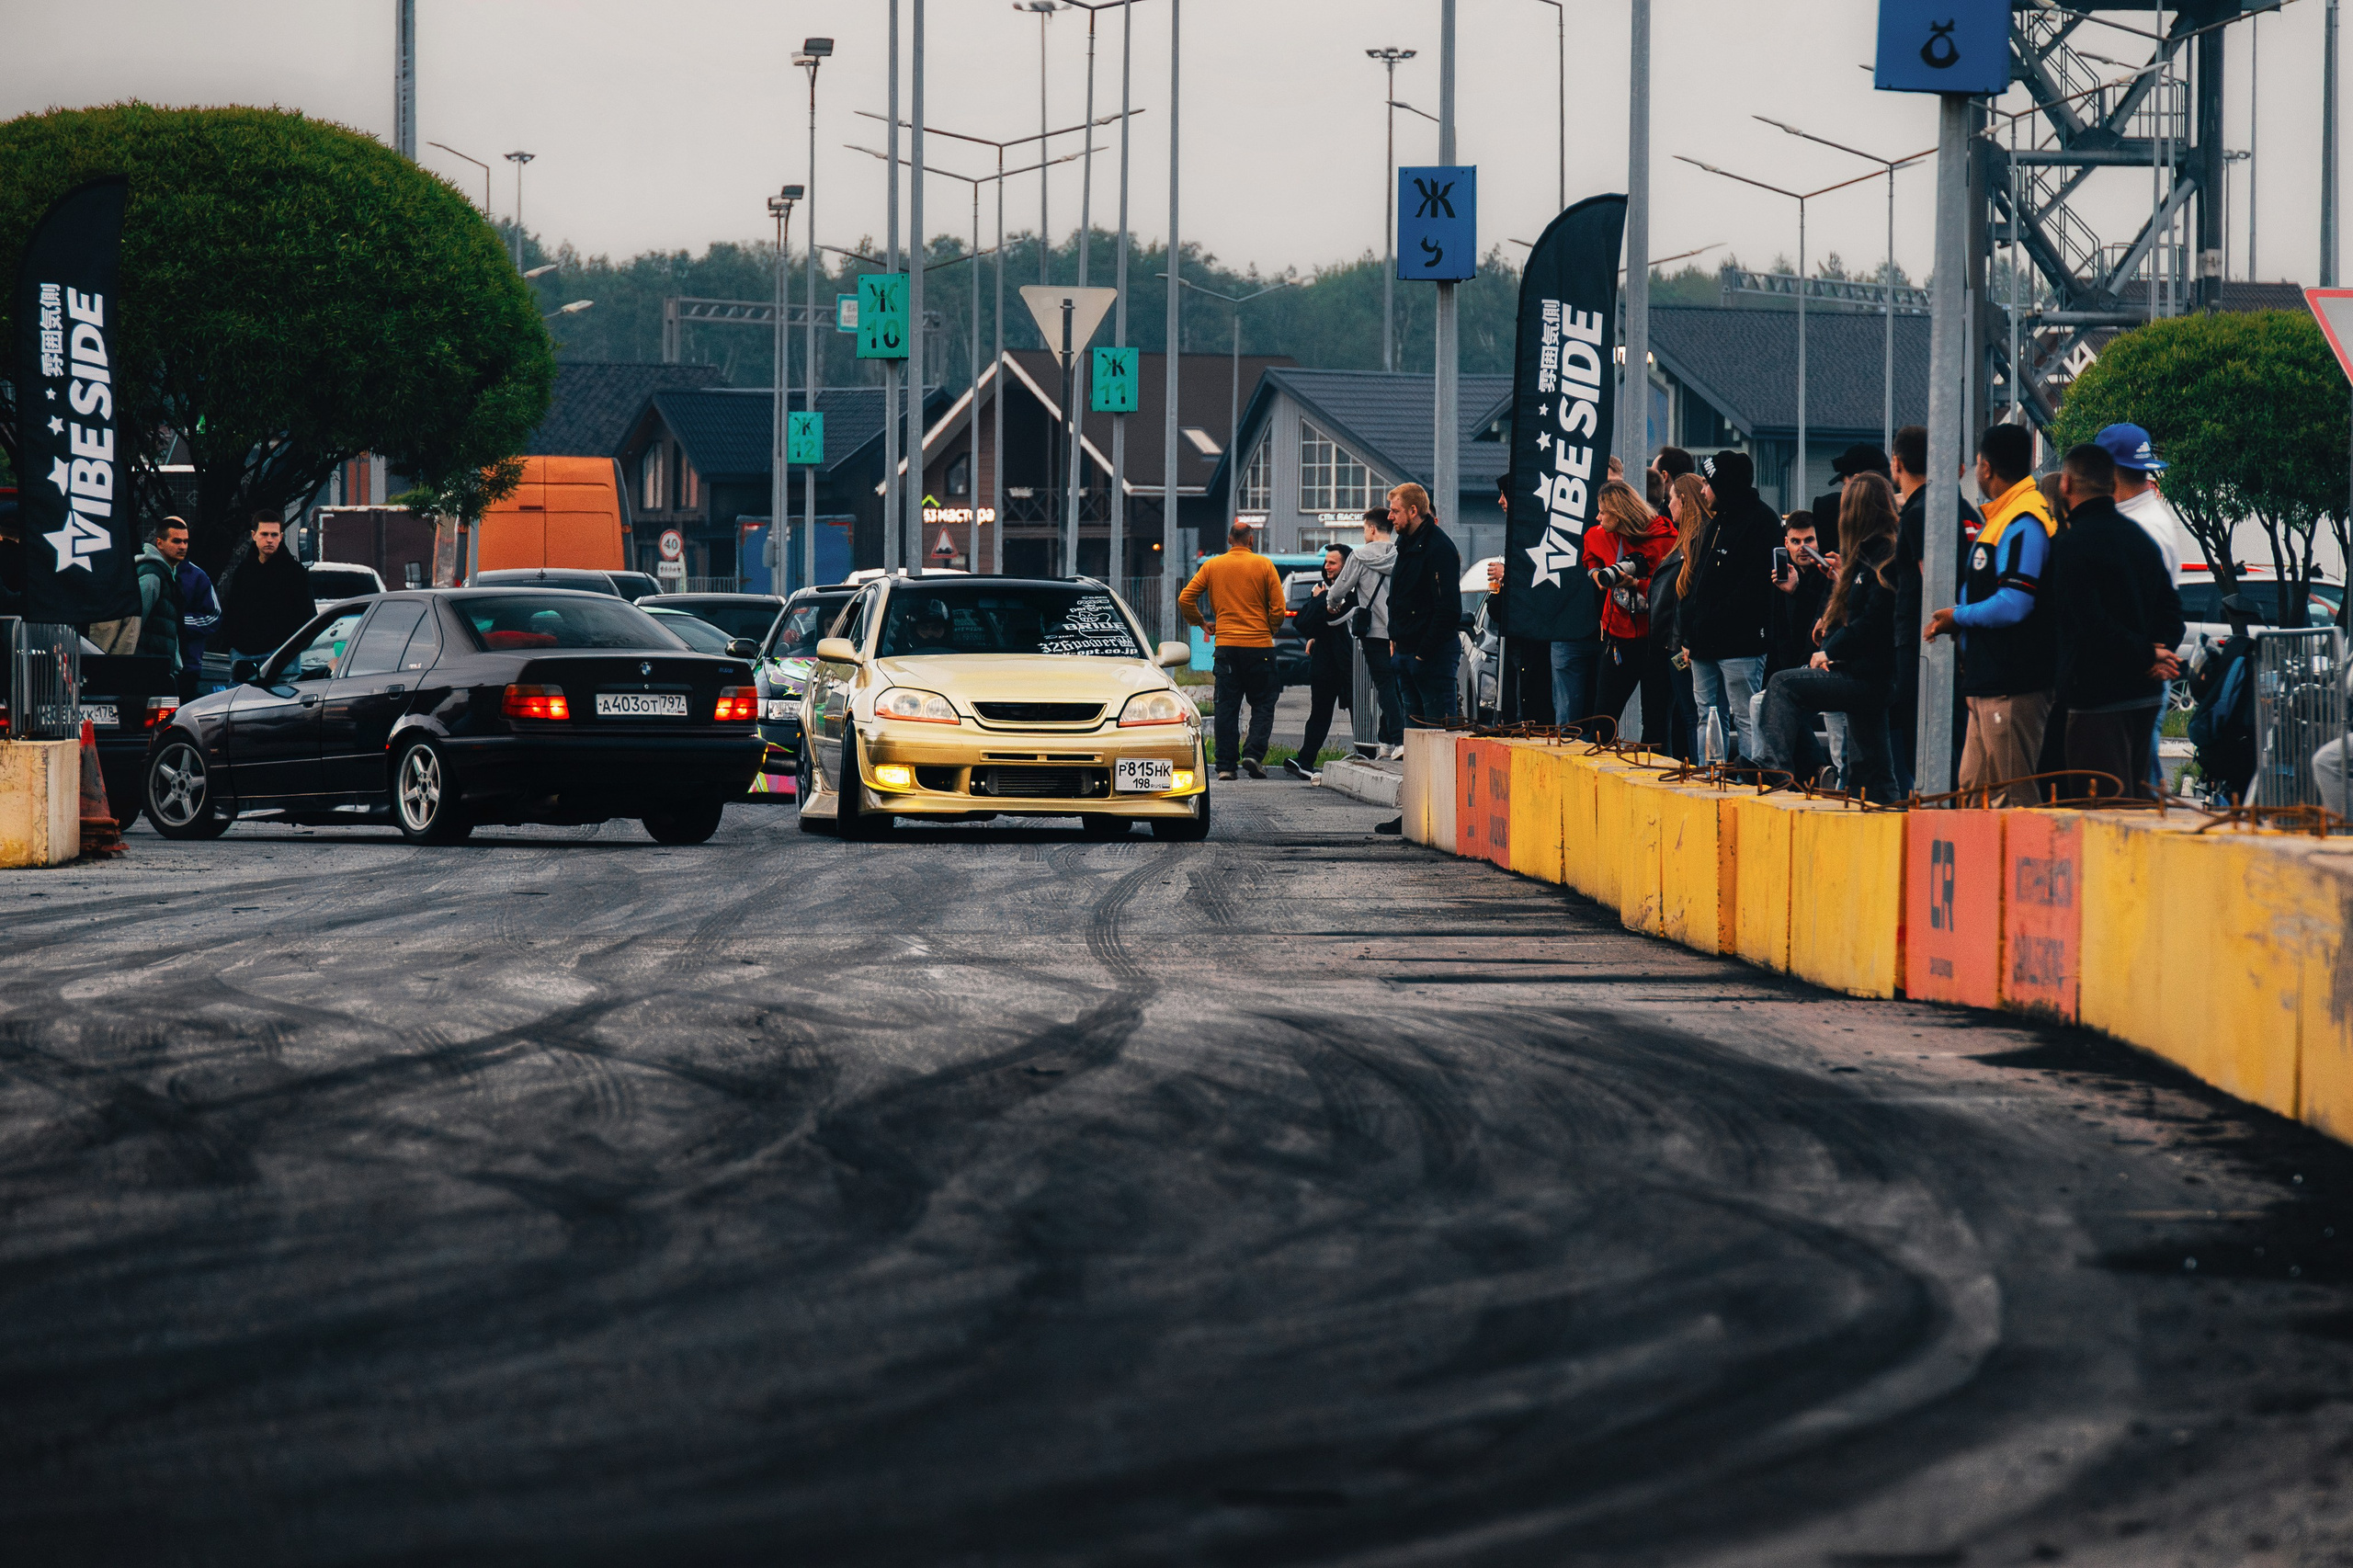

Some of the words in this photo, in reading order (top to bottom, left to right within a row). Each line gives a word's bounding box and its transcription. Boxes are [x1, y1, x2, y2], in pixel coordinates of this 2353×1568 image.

[1414, 177, 1456, 218] Ж
[868, 283, 898, 312] Ж
[40, 283, 63, 377] 雰囲気側
[867, 319, 900, 348] 10
[67, 286, 112, 421] SIDE
[1539, 299, 1561, 393] 雰囲気側
[1101, 353, 1127, 377] Ж
[1559, 302, 1604, 438] SIDE
[1099, 382, 1126, 404] 11
[794, 417, 814, 436] Ж
[792, 440, 815, 458] 12
[70, 422, 114, 554] VIBE
[1547, 438, 1593, 571] VIBE
[664, 539, 678, 550] 40
[602, 696, 658, 712] А403ОТ
[660, 696, 681, 709] 797
[1119, 762, 1171, 777] Р815НК
[1132, 778, 1150, 789] 198
